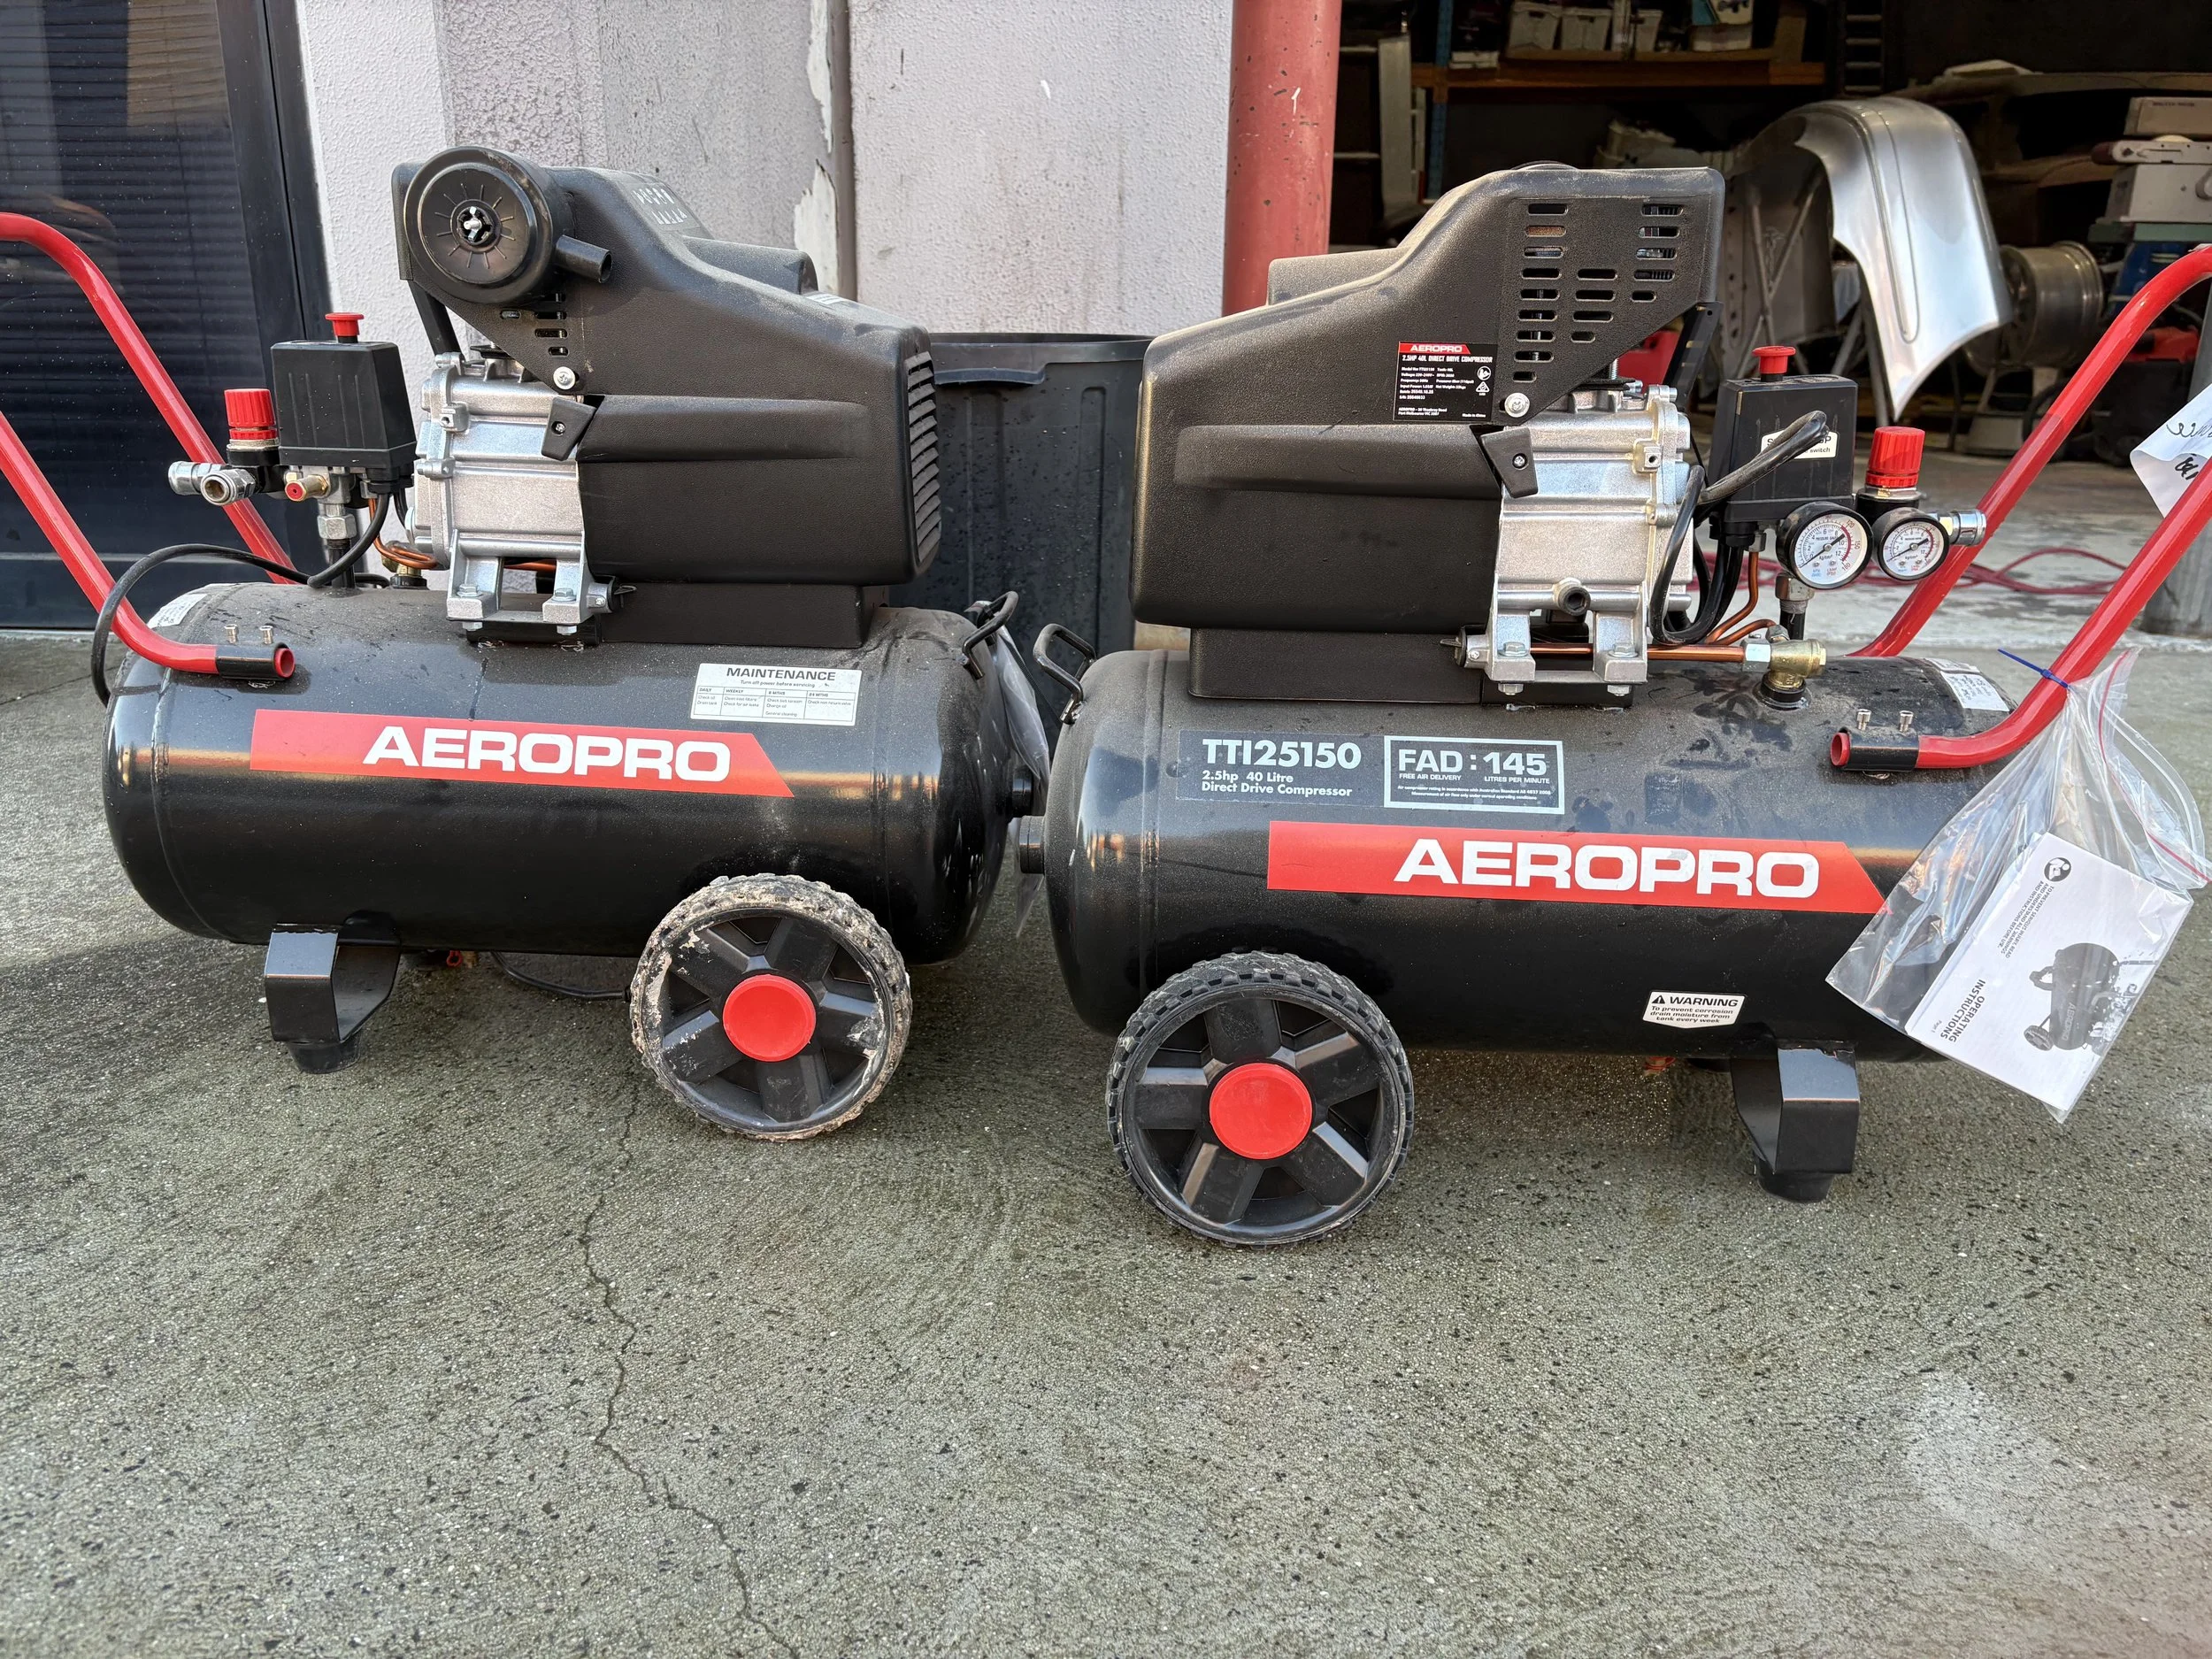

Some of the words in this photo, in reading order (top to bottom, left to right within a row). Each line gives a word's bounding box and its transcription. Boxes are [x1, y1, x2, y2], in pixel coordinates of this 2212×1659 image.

[726, 667, 836, 681] MAINTENANCE
[363, 726, 731, 782] AEROPRO
[1202, 739, 1362, 770] TTI25150
[1483, 752, 1547, 776] 145
[1202, 770, 1239, 783] 2.5hp
[1246, 772, 1263, 781] 40
[1267, 772, 1294, 783] Litre
[1202, 781, 1238, 792] Direct
[1241, 782, 1273, 794] Drive
[1278, 784, 1353, 797] Compressor
[1393, 837, 1820, 898] AEROPRO
[2035, 880, 2044, 892] AND
[2015, 891, 2037, 922] INSTRUCTIONS
[2021, 893, 2041, 922] UNDERSTAND
[2035, 892, 2050, 912] PREVENT
[2003, 921, 2016, 939] BEFORE
[2006, 945, 2015, 958] READ
[1670, 996, 1739, 1007] WARNING
[1940, 979, 1985, 1039] INSTRUCTIONS
[1948, 996, 1985, 1042] OPERATING
